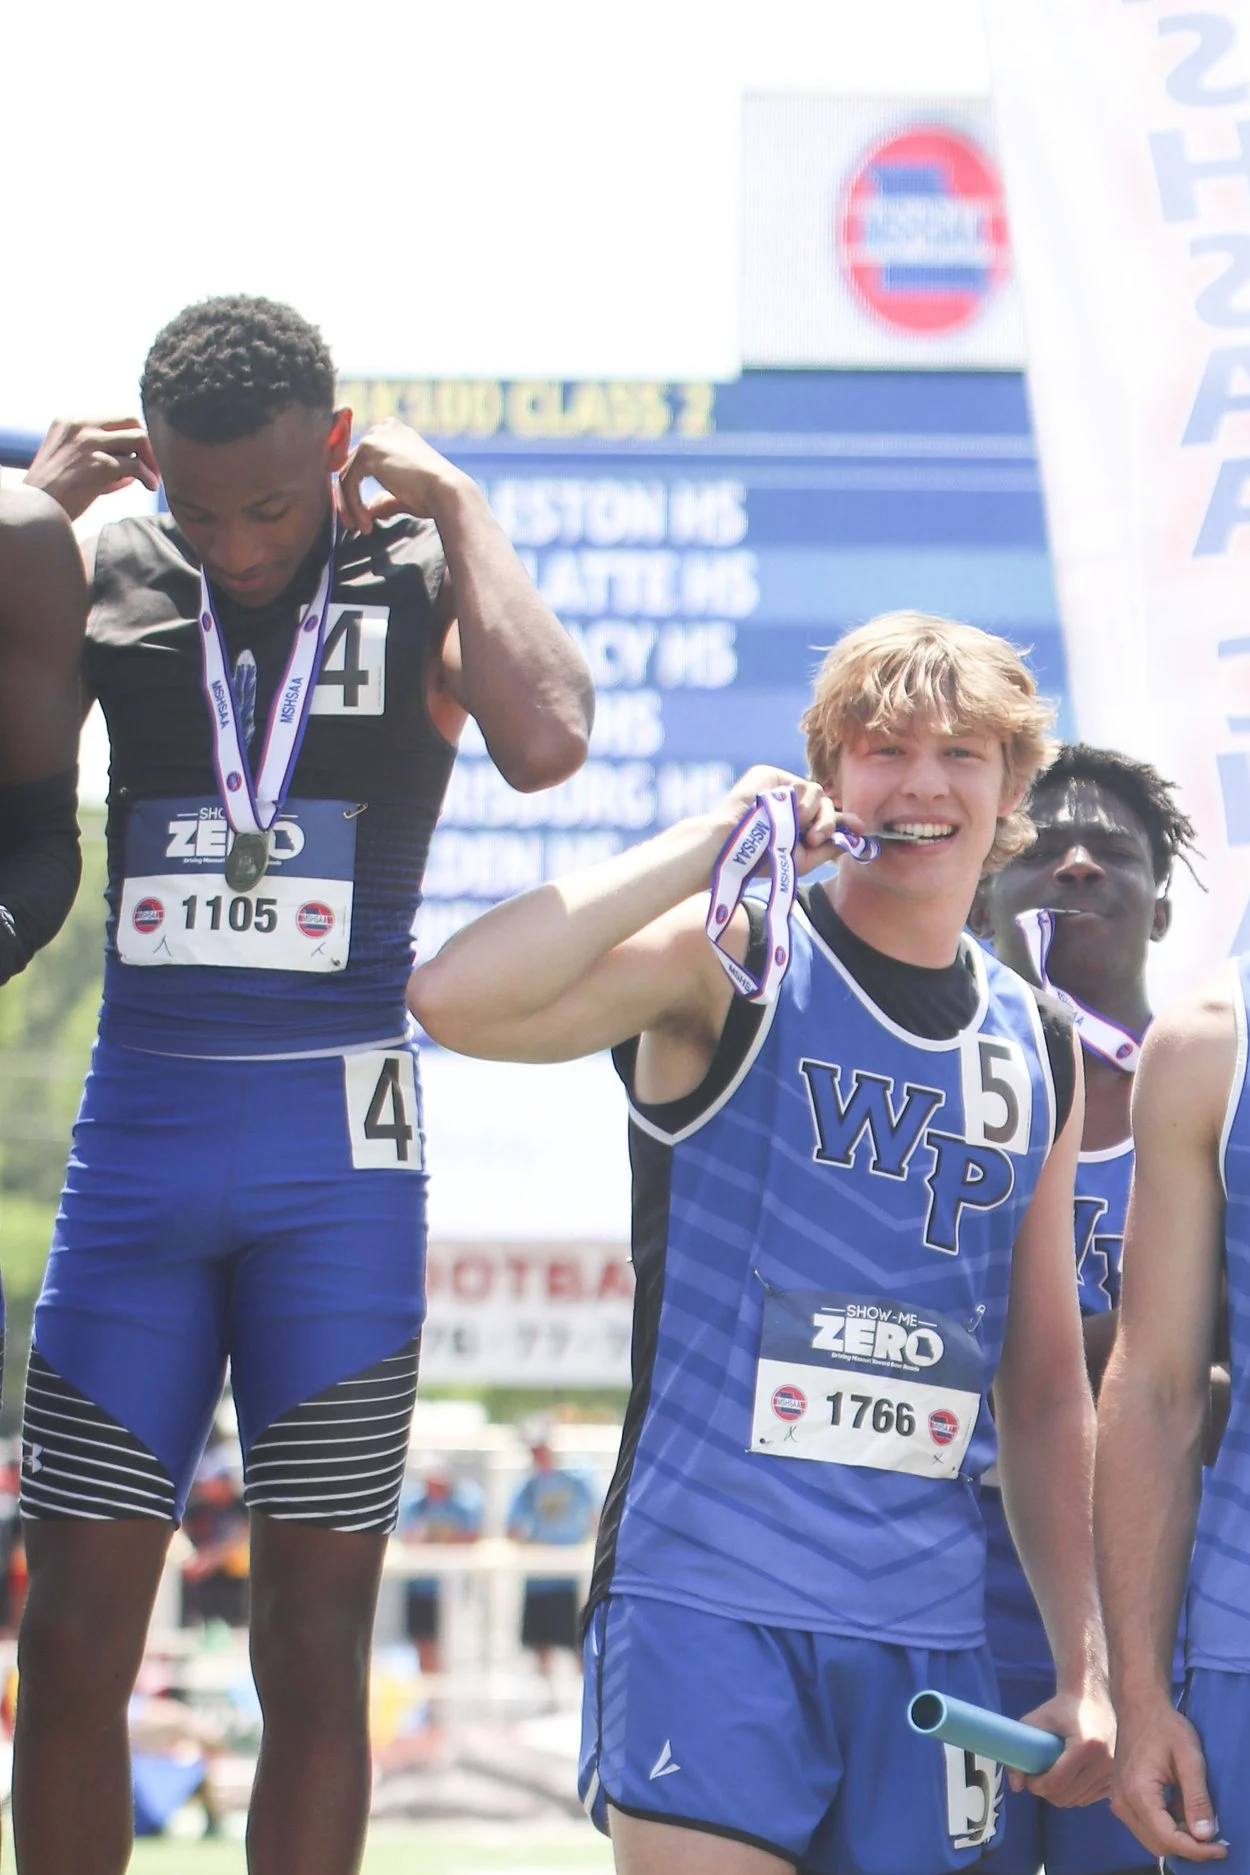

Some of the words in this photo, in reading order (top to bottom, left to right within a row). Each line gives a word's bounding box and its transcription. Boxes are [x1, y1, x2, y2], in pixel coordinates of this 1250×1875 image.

[317, 610, 369, 708] 4
[211, 678, 230, 730] MSHSAA
[280, 676, 304, 724] MSHSAA
[165, 819, 306, 861] ZEO
[733, 820, 771, 866] MSHSAA
[780, 847, 791, 894] MSHSAA
[182, 895, 278, 933] 1105
[363, 1057, 413, 1162] 4
[978, 1040, 1020, 1146] 5
[846, 1304, 918, 1327] SHOW-ME
[811, 1313, 944, 1367] ZERO
[826, 1391, 916, 1437] 1766
